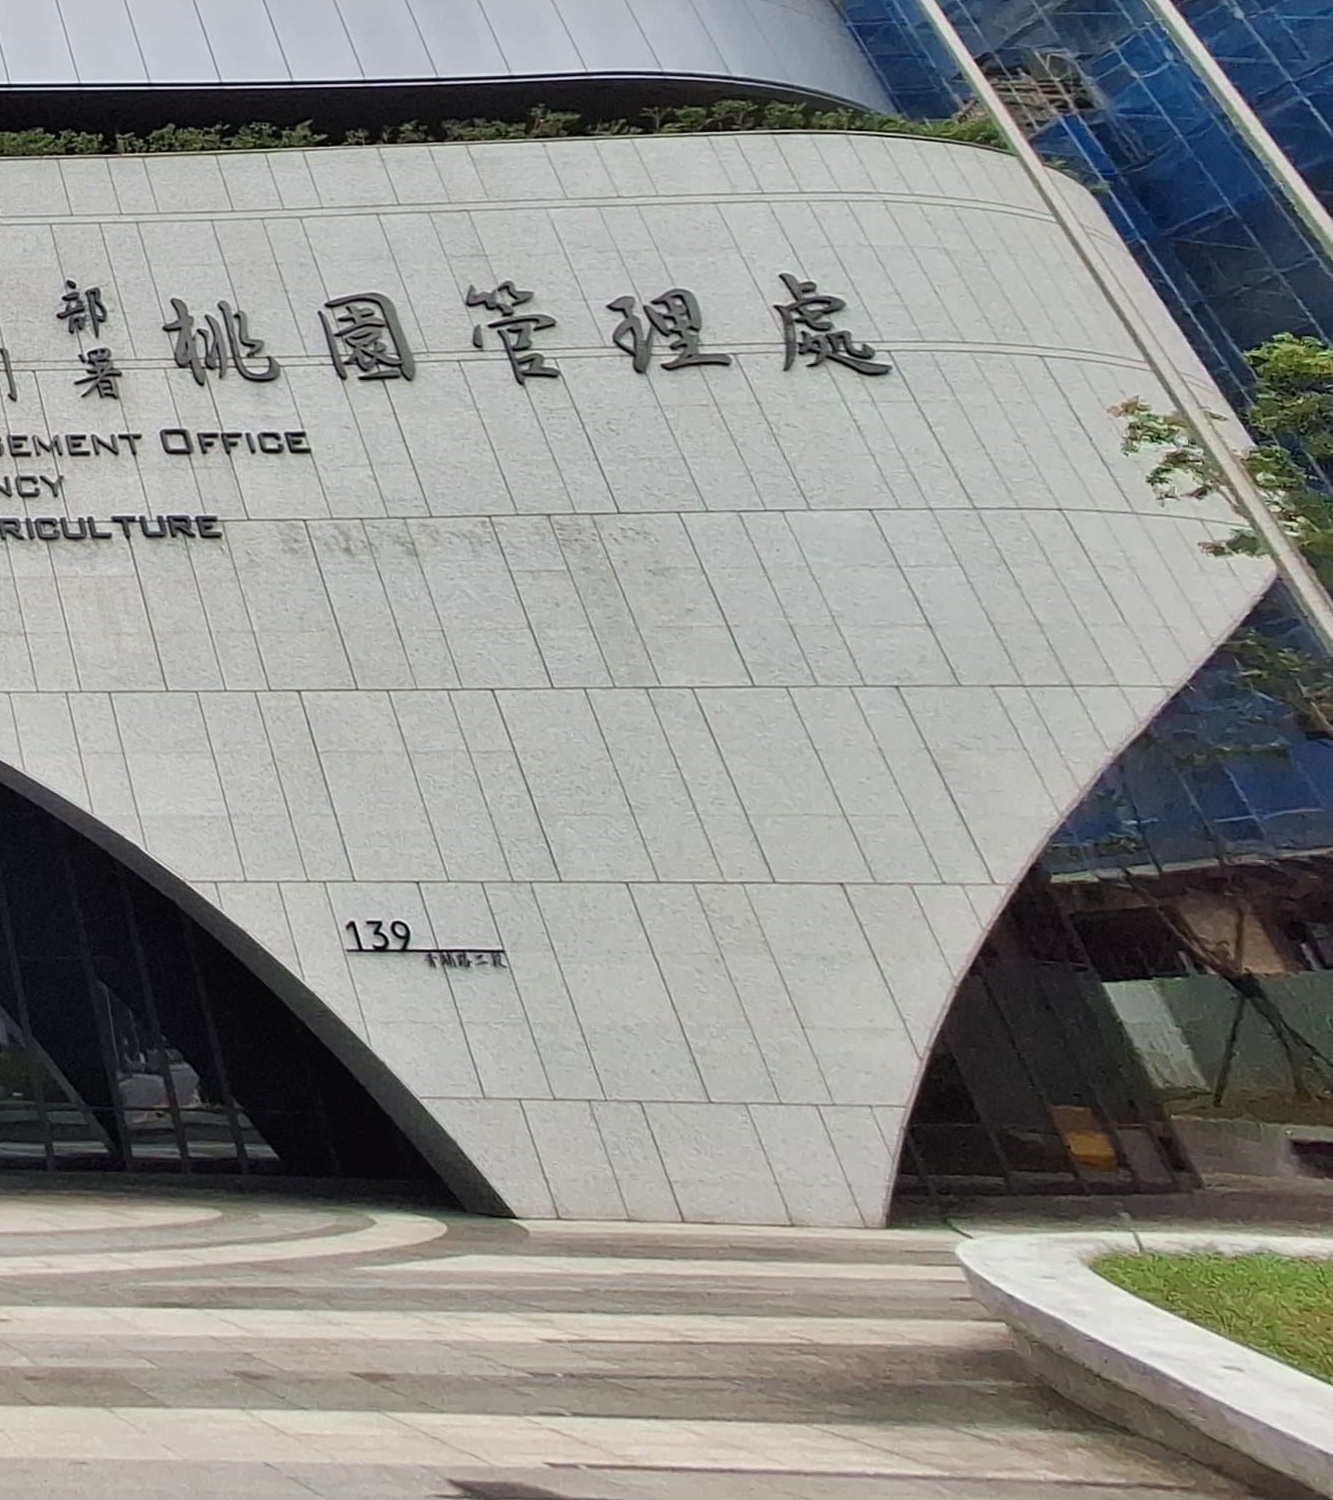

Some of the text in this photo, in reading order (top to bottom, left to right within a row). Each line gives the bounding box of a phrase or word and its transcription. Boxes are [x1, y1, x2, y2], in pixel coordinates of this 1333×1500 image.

[162, 273, 892, 386] 桃園管理處
[159, 428, 312, 457] OFFICE
[345, 919, 412, 951] 139
